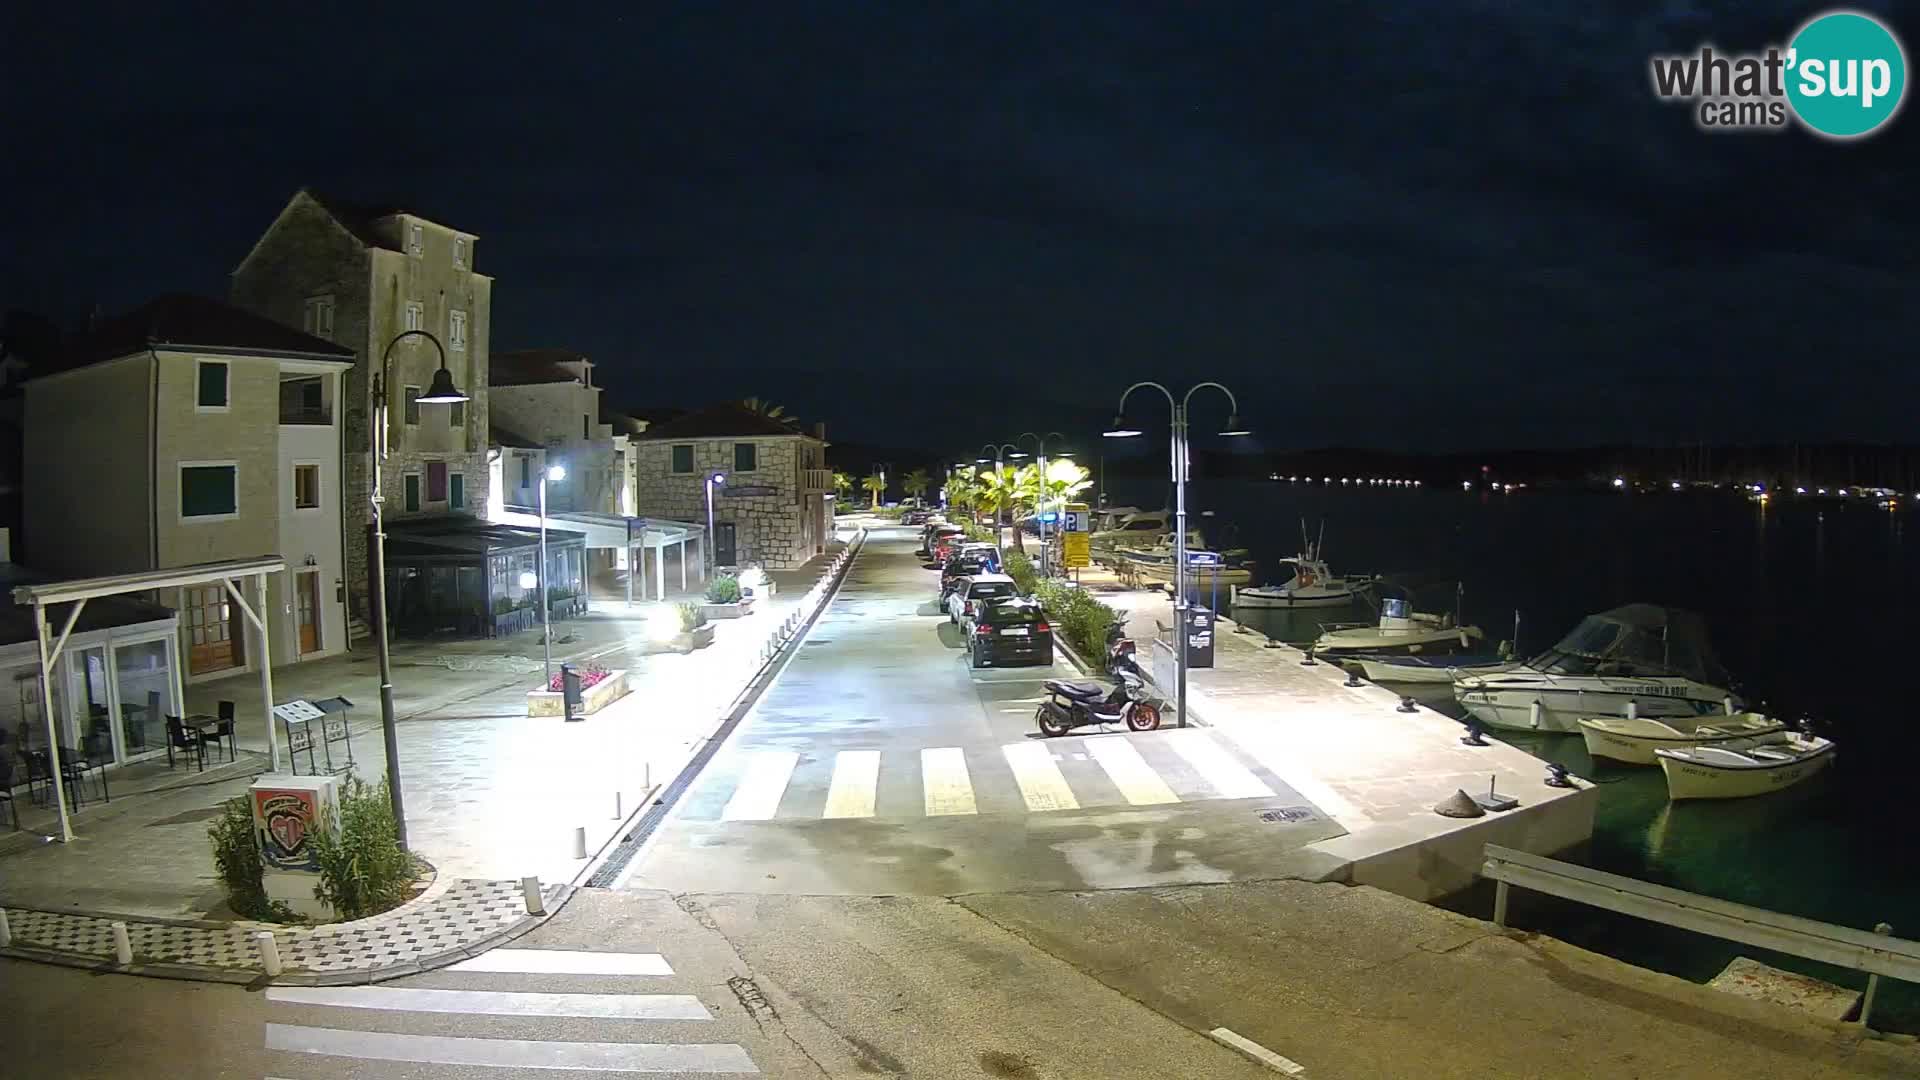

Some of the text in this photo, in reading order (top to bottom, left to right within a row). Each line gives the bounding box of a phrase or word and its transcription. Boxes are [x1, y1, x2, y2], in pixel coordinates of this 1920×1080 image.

[1066, 514, 1076, 530] P
[1645, 686, 1663, 695] RENT
[1664, 686, 1670, 696] A
[1671, 686, 1688, 696] BOAT
